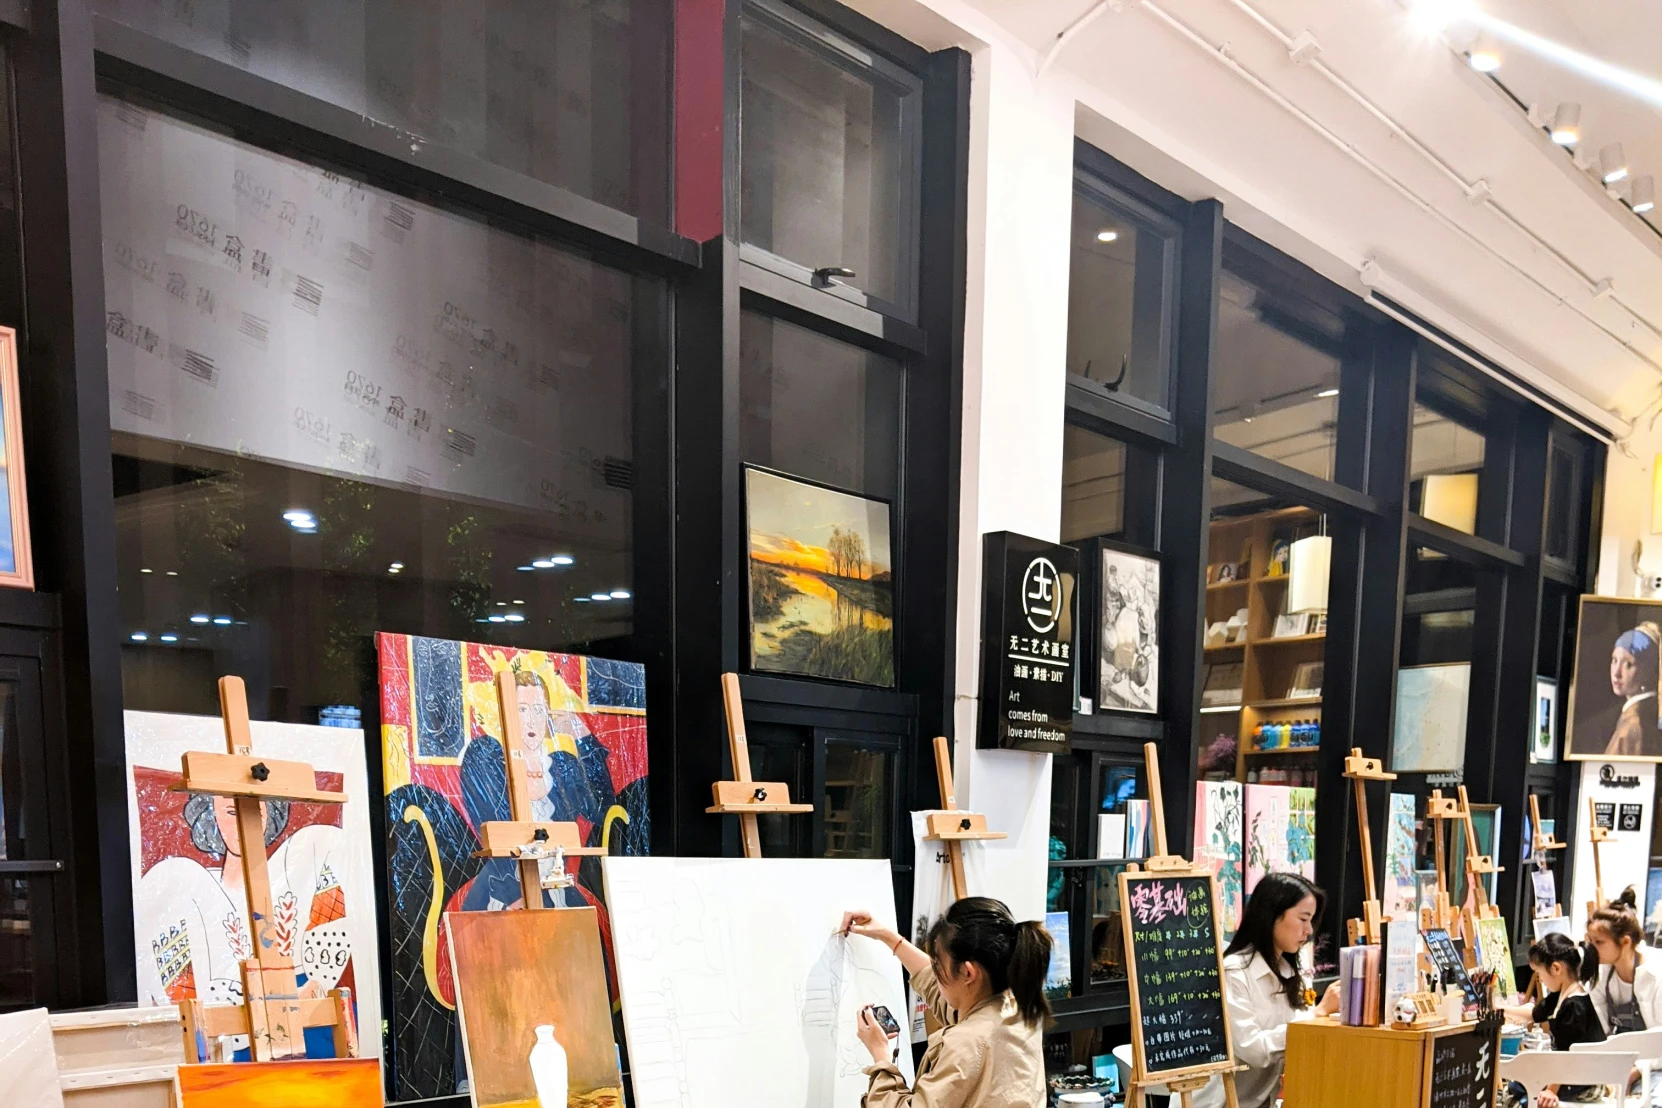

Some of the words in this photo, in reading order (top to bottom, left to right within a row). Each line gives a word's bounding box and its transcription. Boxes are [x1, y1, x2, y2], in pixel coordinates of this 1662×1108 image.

[1009, 635, 1070, 660] 无二艺术画室
[1008, 690, 1021, 703] Art
[1008, 709, 1031, 721] comes
[1031, 709, 1048, 723] from
[1008, 727, 1023, 739] love
[1023, 728, 1038, 740] and
[1037, 729, 1066, 742] freedom
